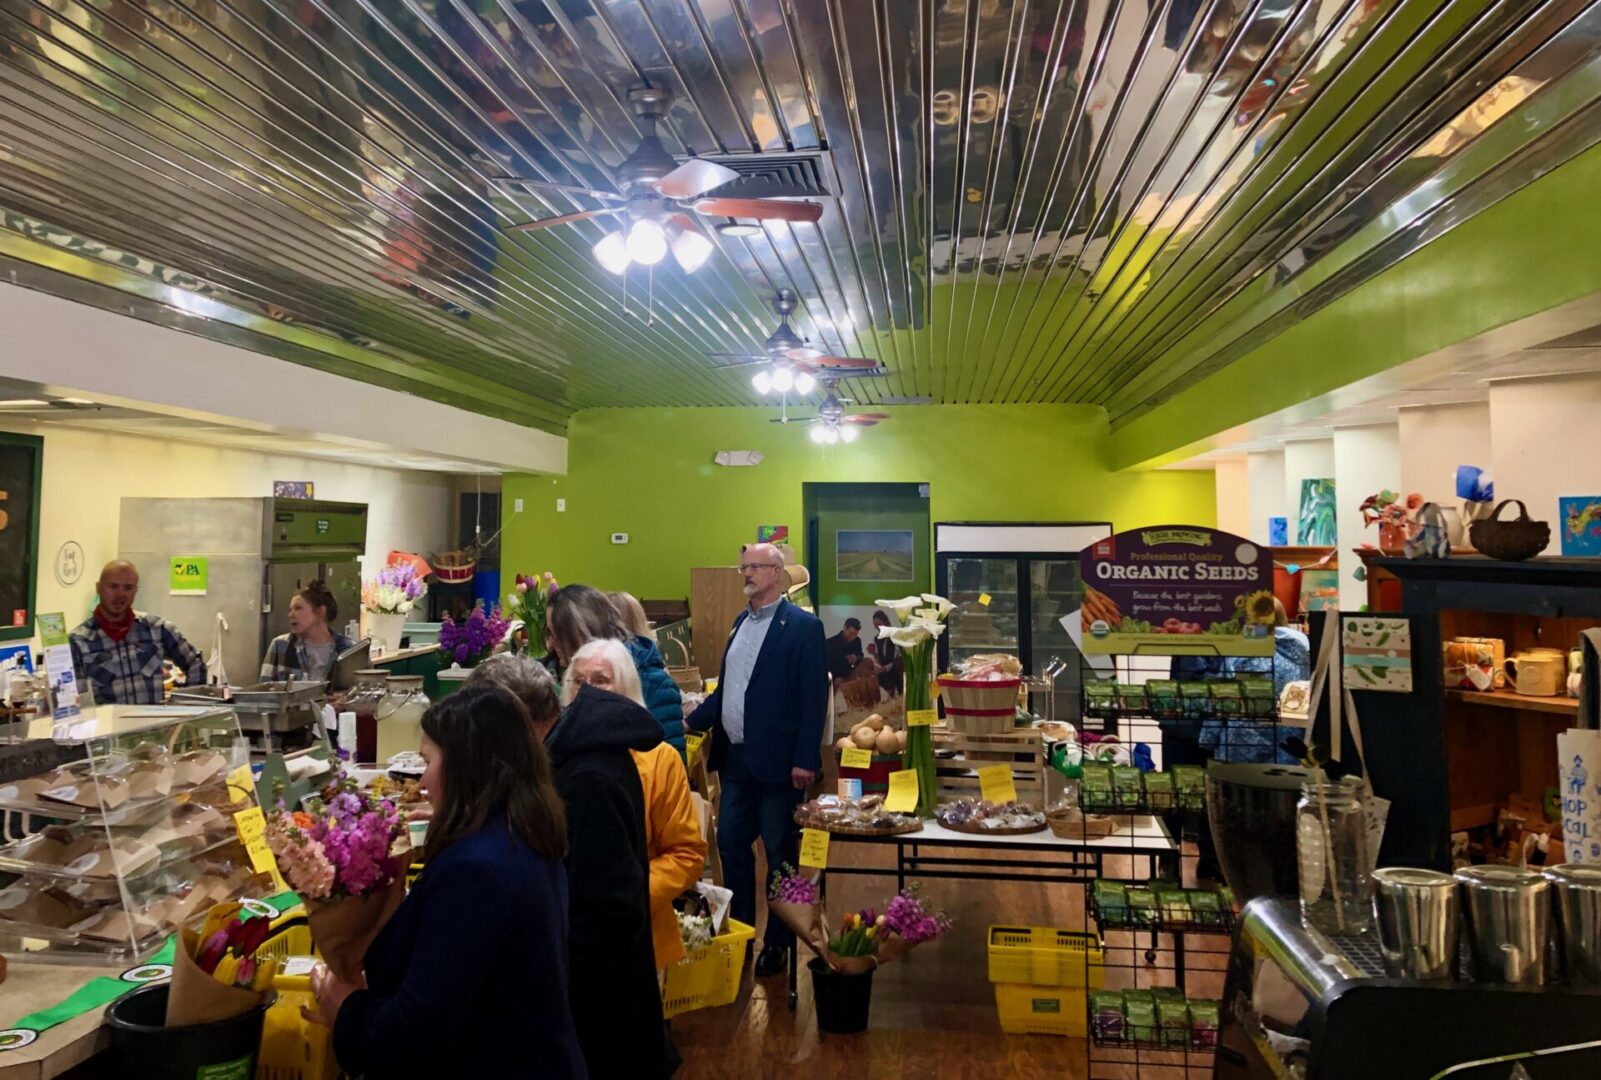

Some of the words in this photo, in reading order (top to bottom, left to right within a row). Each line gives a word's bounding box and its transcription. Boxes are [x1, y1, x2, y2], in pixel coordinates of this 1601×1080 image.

[1130, 552, 1187, 562] Professional
[1188, 553, 1223, 563] Quality
[186, 564, 200, 576] PA
[1096, 562, 1190, 580] ORGANIC
[1194, 562, 1259, 580] SEEDS
[1132, 590, 1159, 600] Because
[1160, 591, 1174, 600] the
[1176, 591, 1192, 600] best
[1132, 604, 1151, 615] grow
[1152, 602, 1172, 612] from
[1173, 602, 1187, 612] the
[1188, 603, 1203, 612] best
